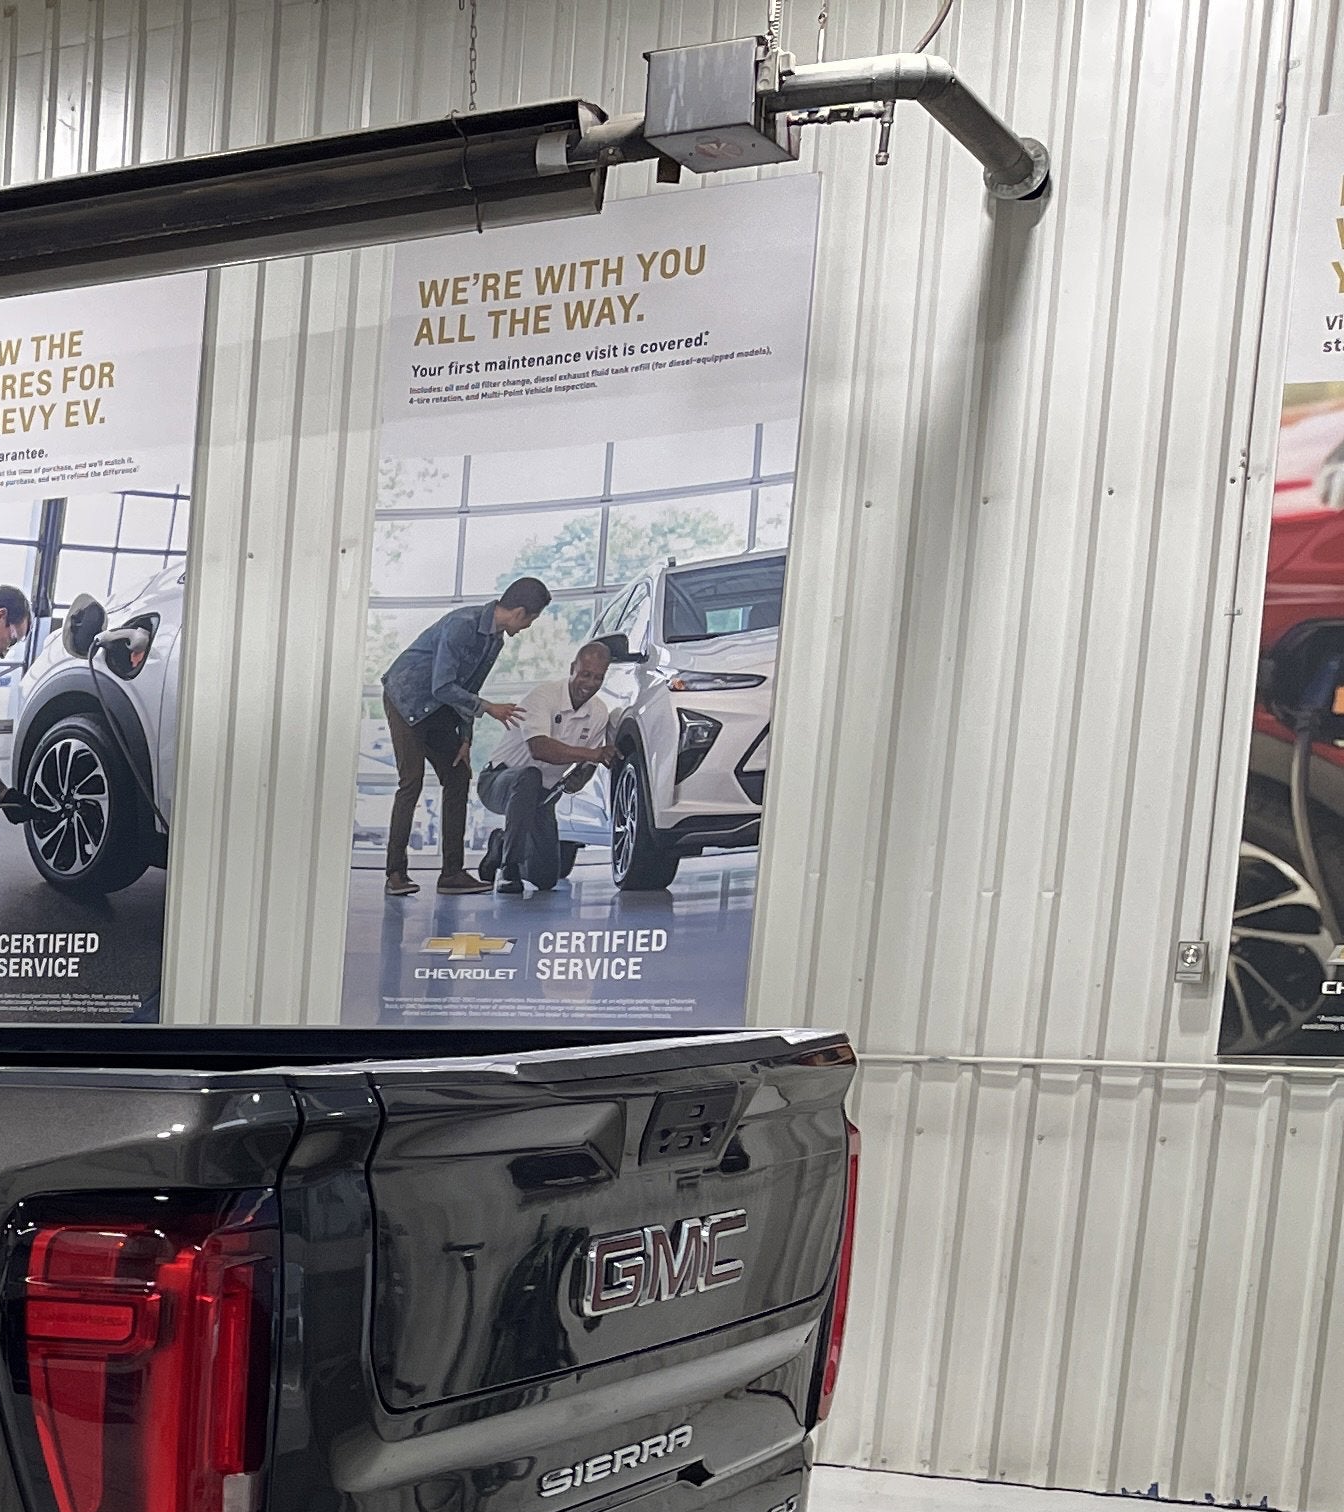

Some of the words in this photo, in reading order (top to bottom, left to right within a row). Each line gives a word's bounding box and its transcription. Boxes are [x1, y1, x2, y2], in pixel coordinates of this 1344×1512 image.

[418, 269, 524, 309] WE'RE
[534, 256, 624, 295] WITH
[636, 244, 707, 282] YOU
[414, 314, 476, 347] ALL
[487, 304, 552, 339] THE
[563, 293, 646, 332] WAY.
[31, 330, 84, 361] THE
[411, 364, 444, 378] Your
[448, 360, 480, 375] first
[484, 348, 582, 372] maintenance
[585, 344, 618, 361] visit
[622, 342, 635, 356] is
[63, 362, 115, 392] FOR
[533, 374, 557, 384] diesel
[558, 370, 590, 381] exhaust
[65, 398, 106, 428] EV.
[538, 929, 668, 954] CERTIFIED
[414, 967, 519, 980] CHEVROLET
[536, 957, 643, 981] SERVICE
[577, 1209, 749, 1318] GMC
[538, 1424, 694, 1498] SIERRA
